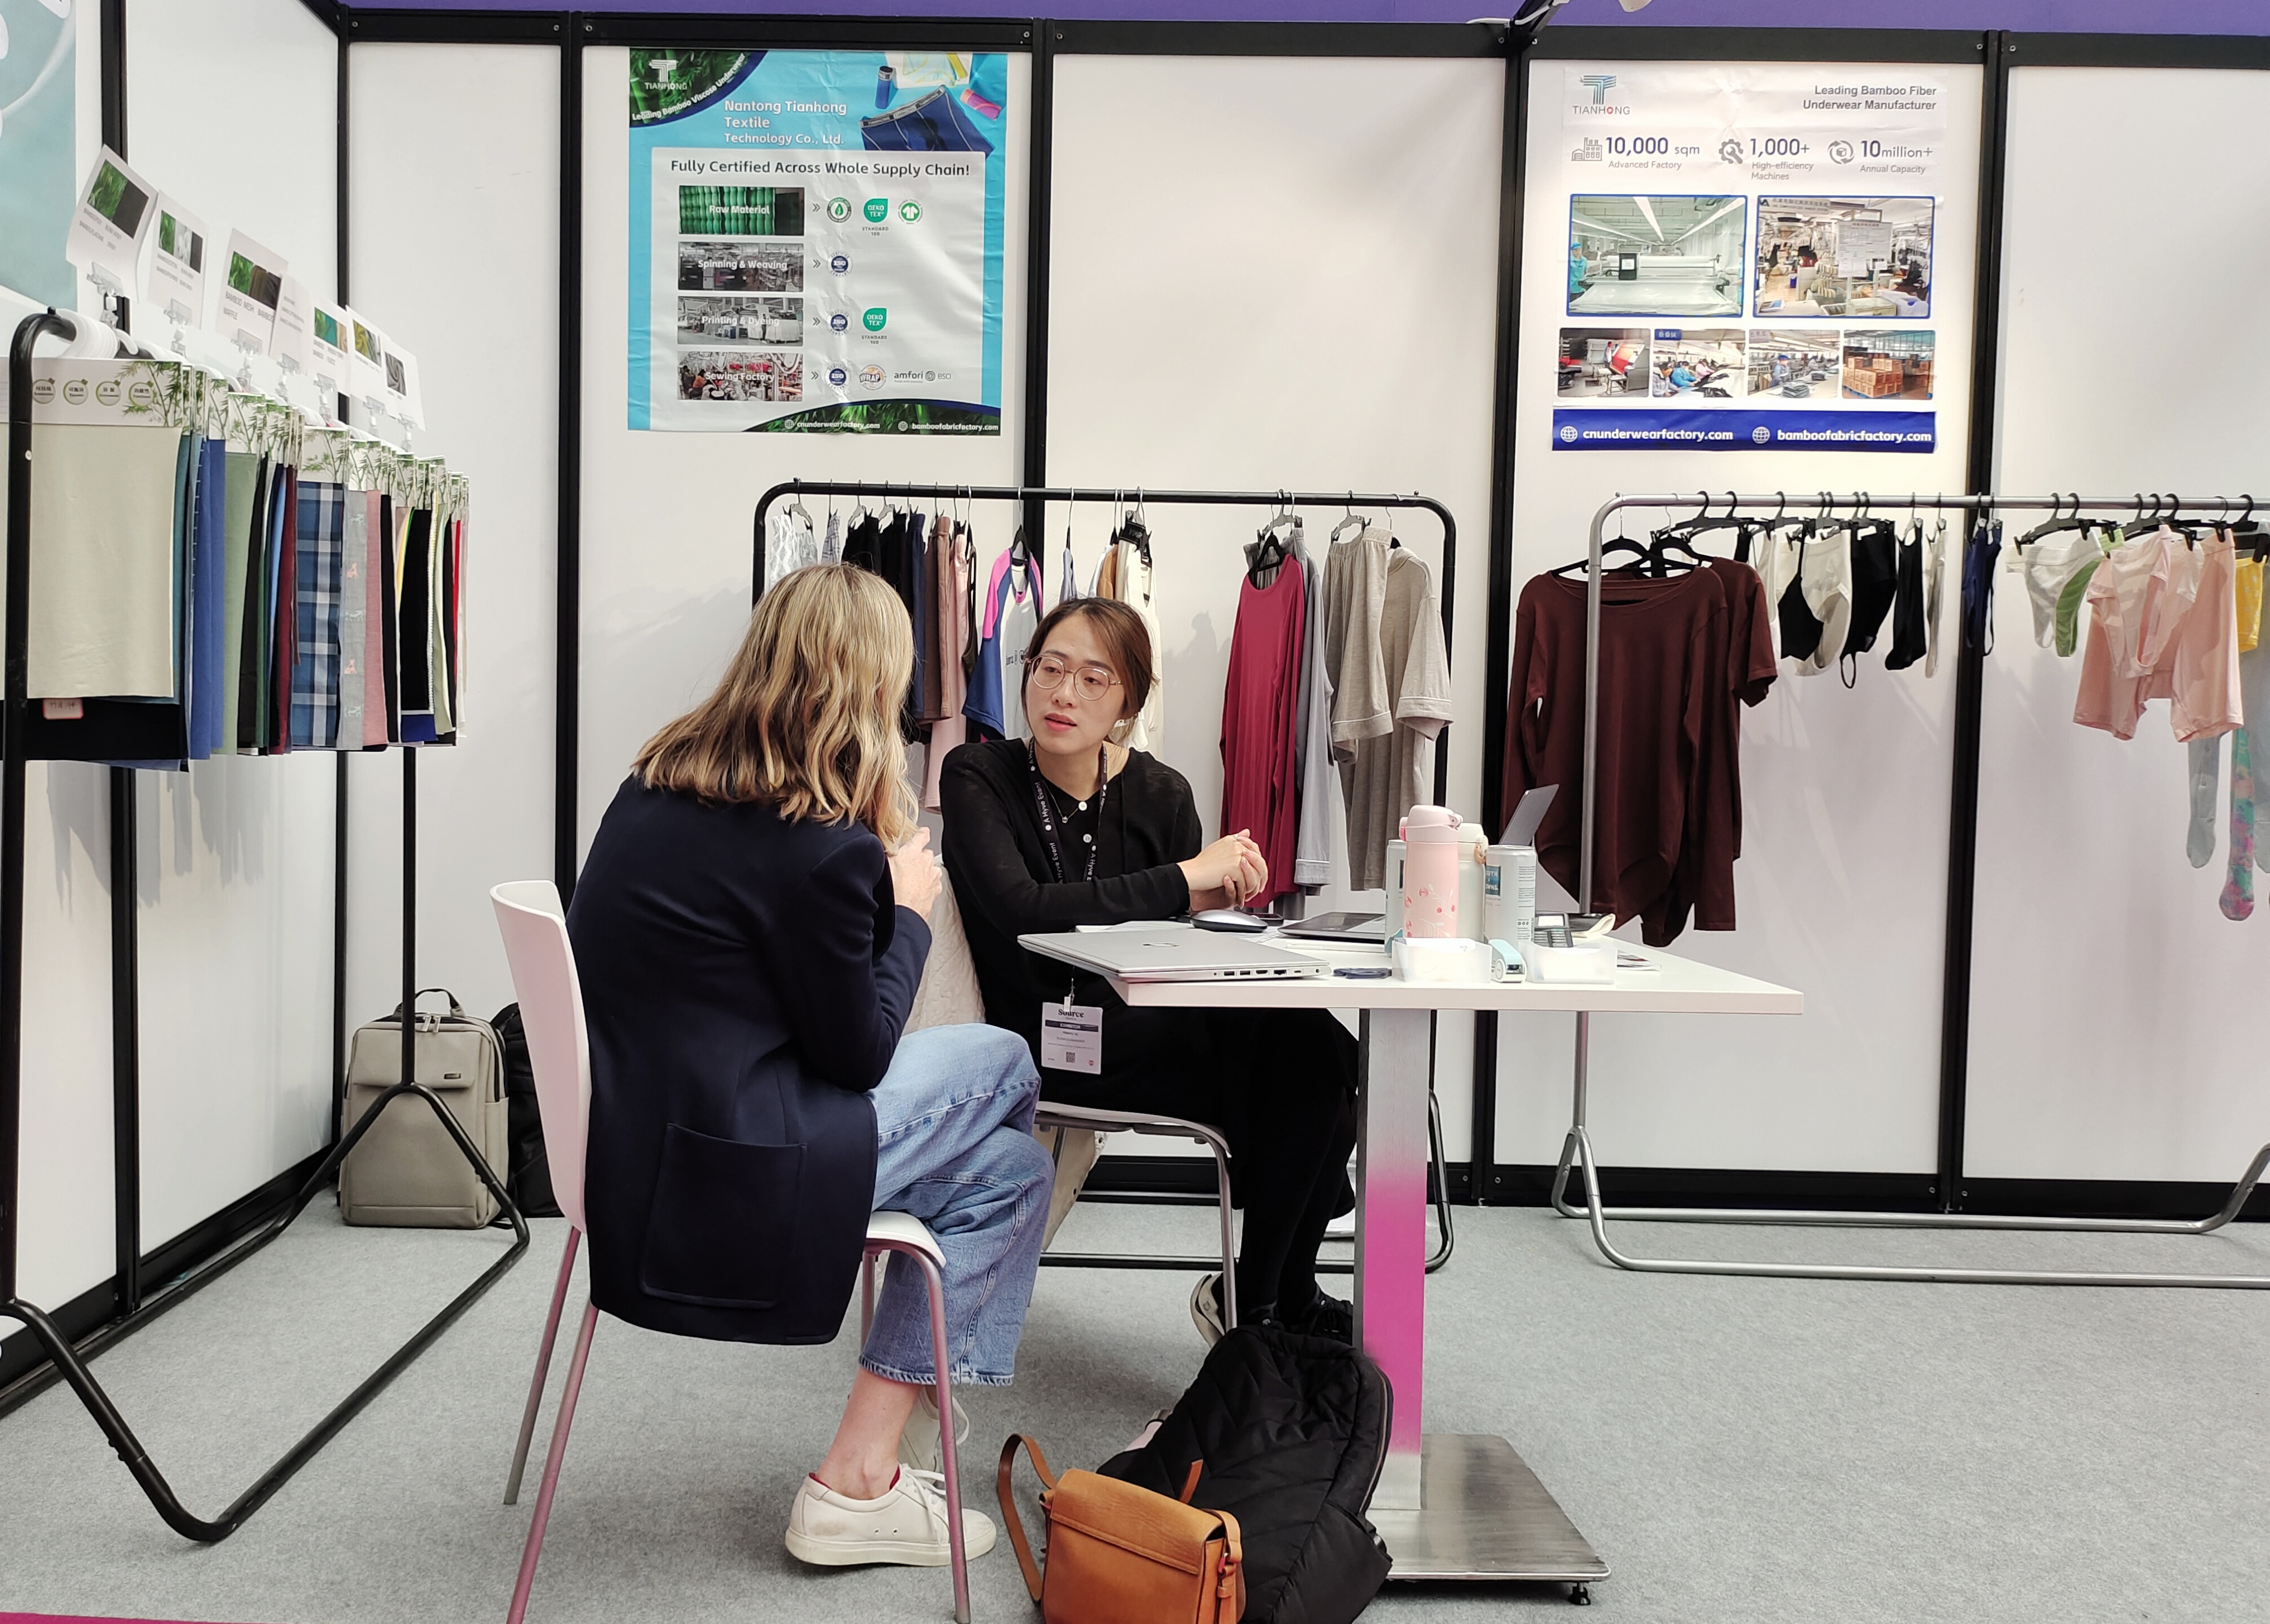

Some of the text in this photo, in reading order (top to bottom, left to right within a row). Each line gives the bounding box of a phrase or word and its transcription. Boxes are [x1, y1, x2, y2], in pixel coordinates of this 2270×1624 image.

[632, 52, 746, 121] Leading Bamboo Viscose Underwear
[645, 82, 688, 90] TIANHONG
[1815, 85, 1937, 97] Leading Bamboo Fiber
[724, 100, 847, 116] Nantong Tianhong
[1803, 99, 1937, 109] Underwear Manufacturer
[1572, 105, 1630, 115] TIANHONG
[724, 116, 770, 128] Textile
[724, 133, 844, 146] Technology Co., Ltd.
[1605, 137, 1700, 157] 10,000 sqm
[1750, 138, 1810, 158] 1,000+
[671, 160, 970, 178] Fully Certified Across Whole Supply Chain!
[1652, 161, 1682, 171] Factory
[1752, 161, 1814, 172] High-efficiency
[1891, 165, 1926, 174] Capacity
[709, 205, 770, 214] Raw Material
[698, 260, 737, 270] Spinning
[748, 260, 788, 272] Weaving
[702, 316, 737, 326] Printing
[748, 318, 779, 326] Dyeing
[705, 372, 775, 382] Sewing Factory
[860, 373, 880, 382] WRAP
[894, 371, 923, 379] amfori
[797, 421, 999, 431] cnunderwearfactory.com bamboofabricfactory.com
[1583, 429, 1932, 444] cnunderwearfactory.com bamboofabricfactory.com
[1041, 801, 1050, 818] Hyve
